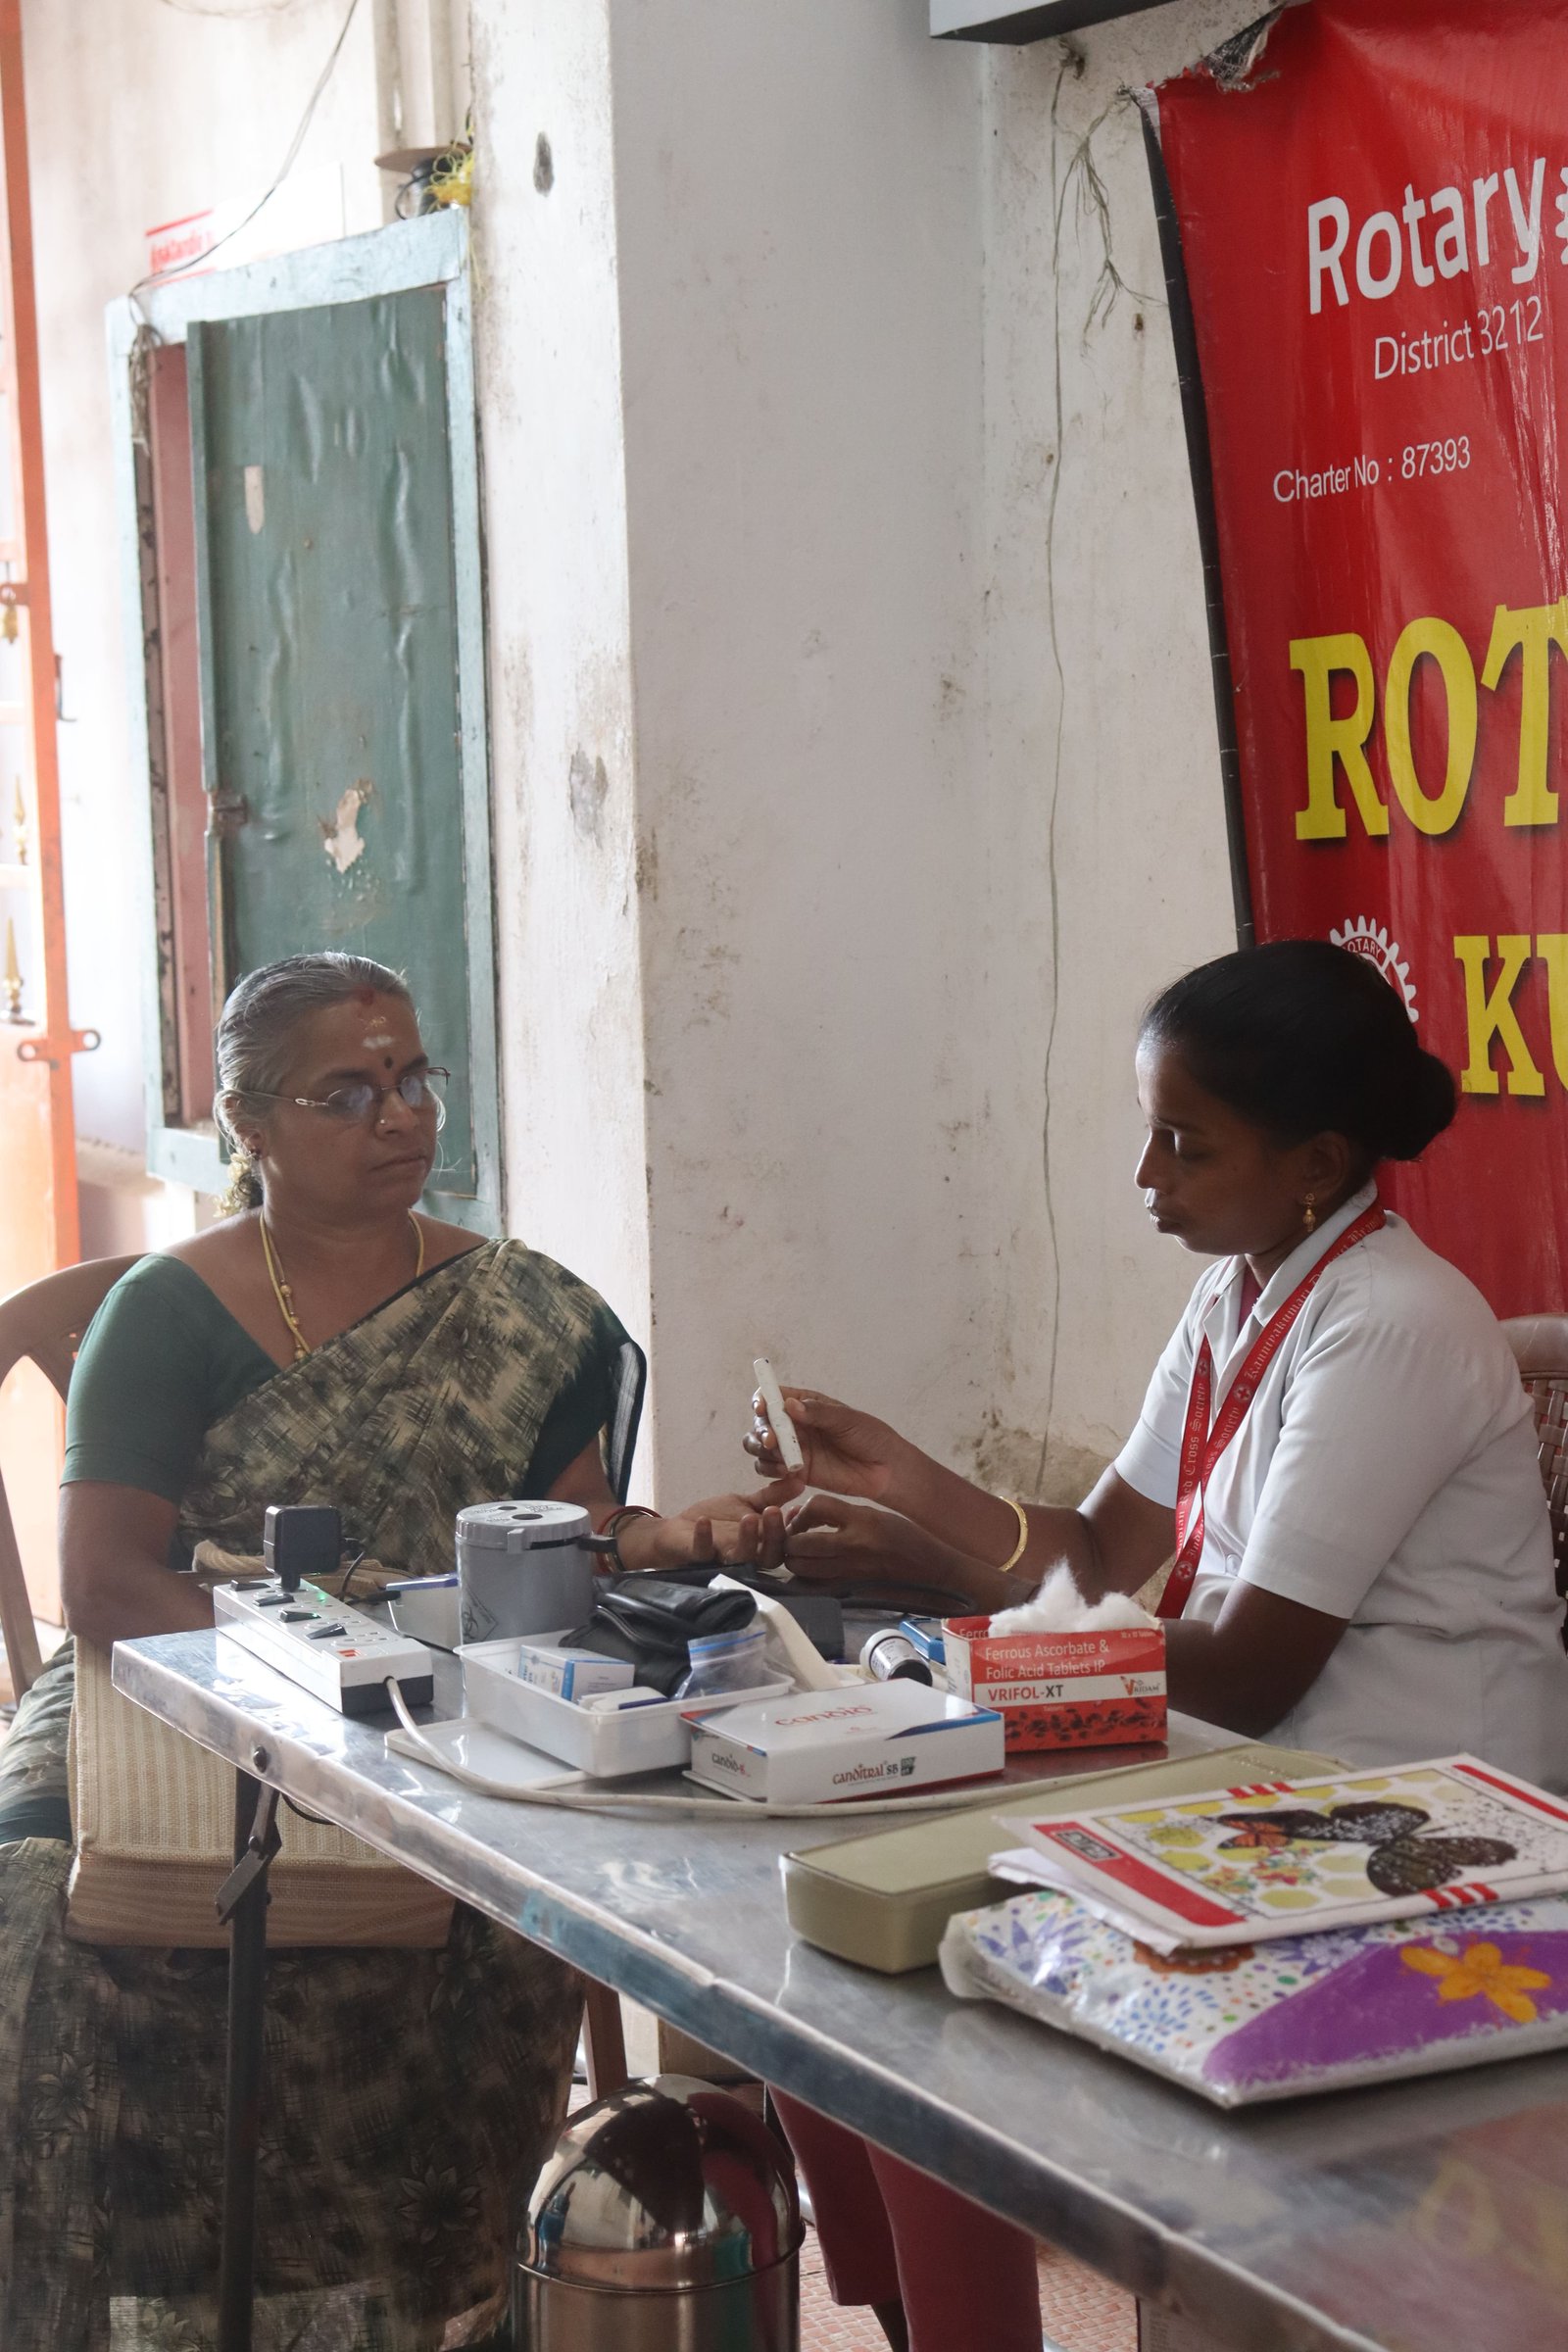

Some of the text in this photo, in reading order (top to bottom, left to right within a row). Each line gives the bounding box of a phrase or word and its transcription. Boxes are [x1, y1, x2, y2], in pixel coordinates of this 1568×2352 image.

[1307, 157, 1546, 315] Rotary
[1374, 296, 1544, 380] District 3212
[1274, 461, 1351, 502] Charter
[1353, 456, 1380, 488] No
[1400, 436, 1471, 479] 87393
[1343, 938, 1382, 959] OTARY
[1190, 1383, 1205, 1432] Society
[1214, 1406, 1241, 1448] Society
[1184, 1437, 1200, 1476] Cross
[1179, 1481, 1194, 1506] Red
[985, 1639, 1109, 1661] Ferrous Ascorbate &
[986, 1659, 1105, 1680] Folic Acid Tablets IP
[988, 1684, 1063, 1701] VRIFOL-XT
